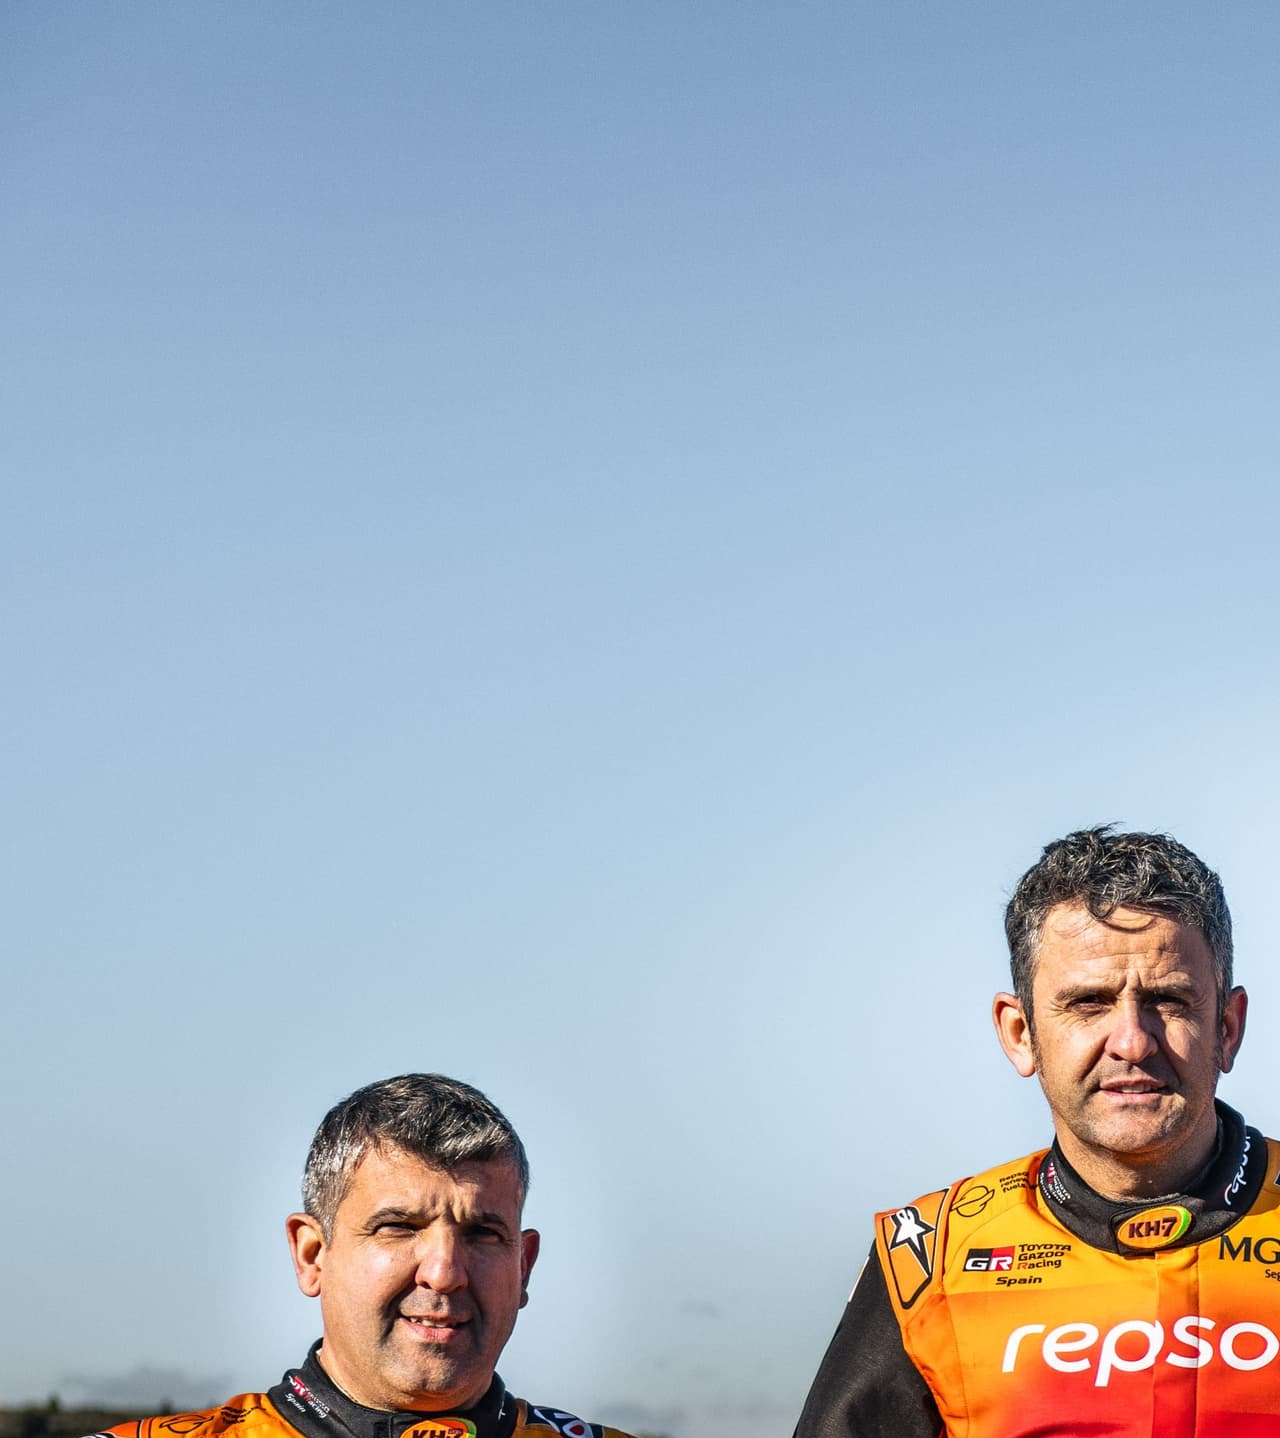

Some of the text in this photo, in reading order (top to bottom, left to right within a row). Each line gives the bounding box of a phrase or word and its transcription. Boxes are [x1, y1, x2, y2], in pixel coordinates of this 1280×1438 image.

[1018, 1243, 1072, 1253] TOYOTA
[1018, 1251, 1065, 1262] GAZOO
[964, 1257, 1014, 1271] GR
[1016, 1259, 1062, 1269] Racing
[995, 1275, 1043, 1287] Spain
